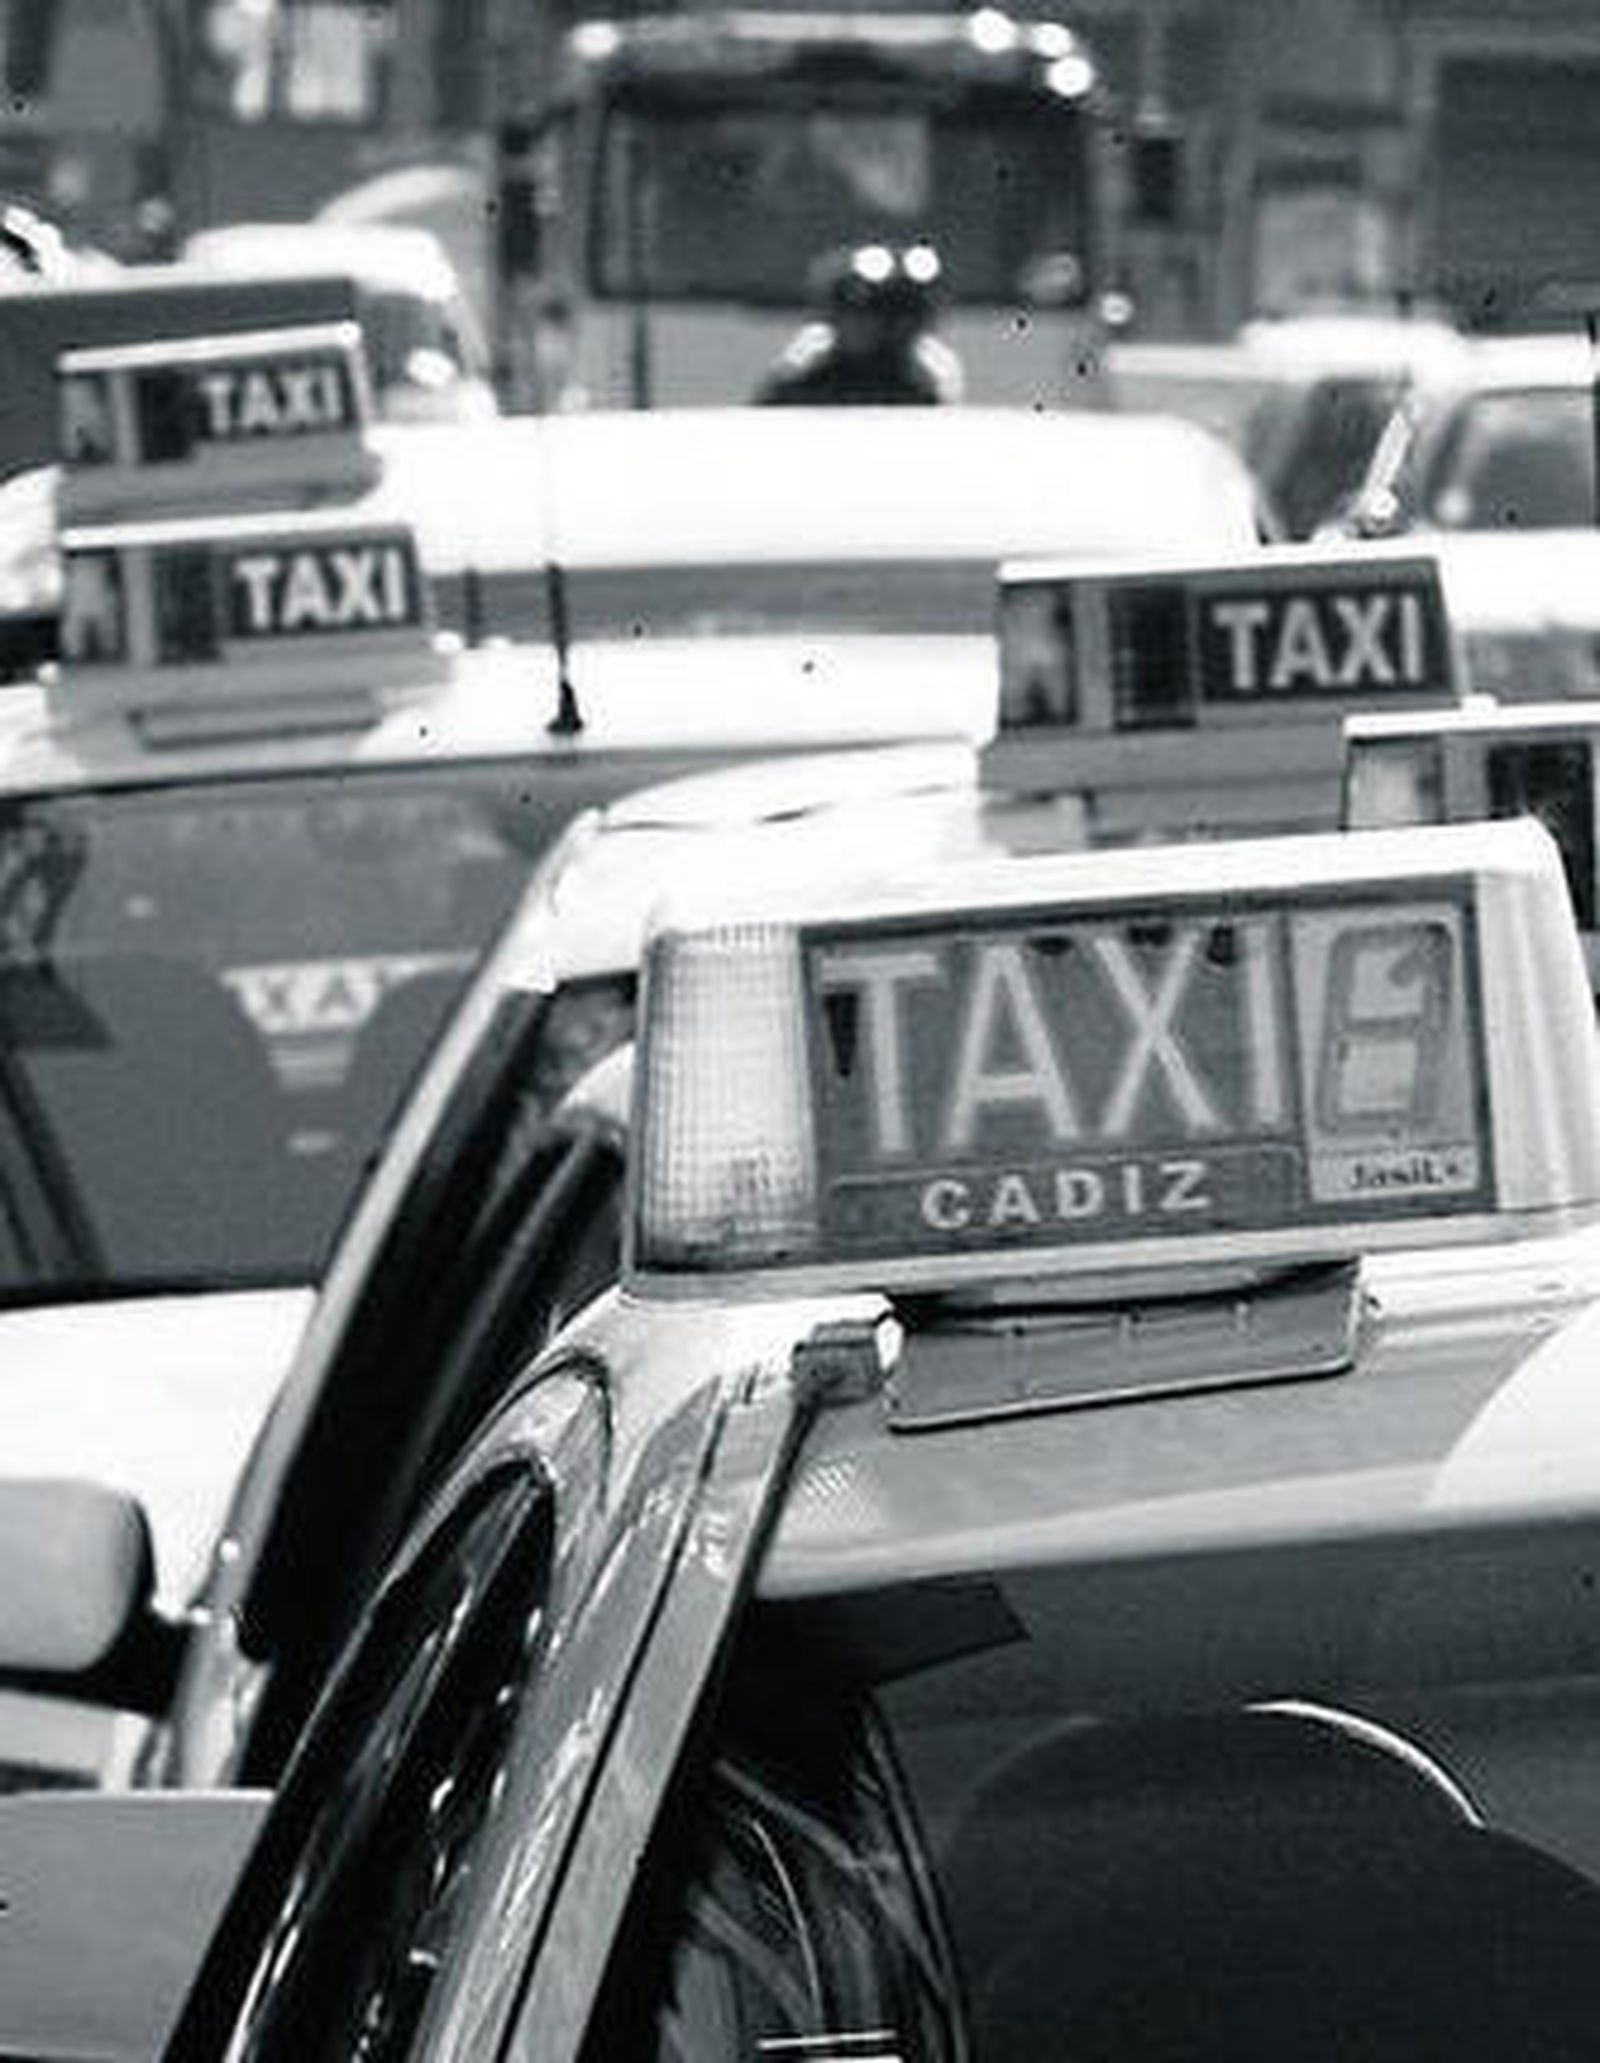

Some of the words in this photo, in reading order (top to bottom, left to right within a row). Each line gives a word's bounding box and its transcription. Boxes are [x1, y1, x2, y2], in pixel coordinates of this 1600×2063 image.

[203, 365, 344, 434] TAXI
[233, 549, 405, 629] TAXI
[1213, 594, 1424, 688] TAXI
[820, 924, 1285, 1152] TAXI
[921, 1160, 1213, 1230] CADIZ
